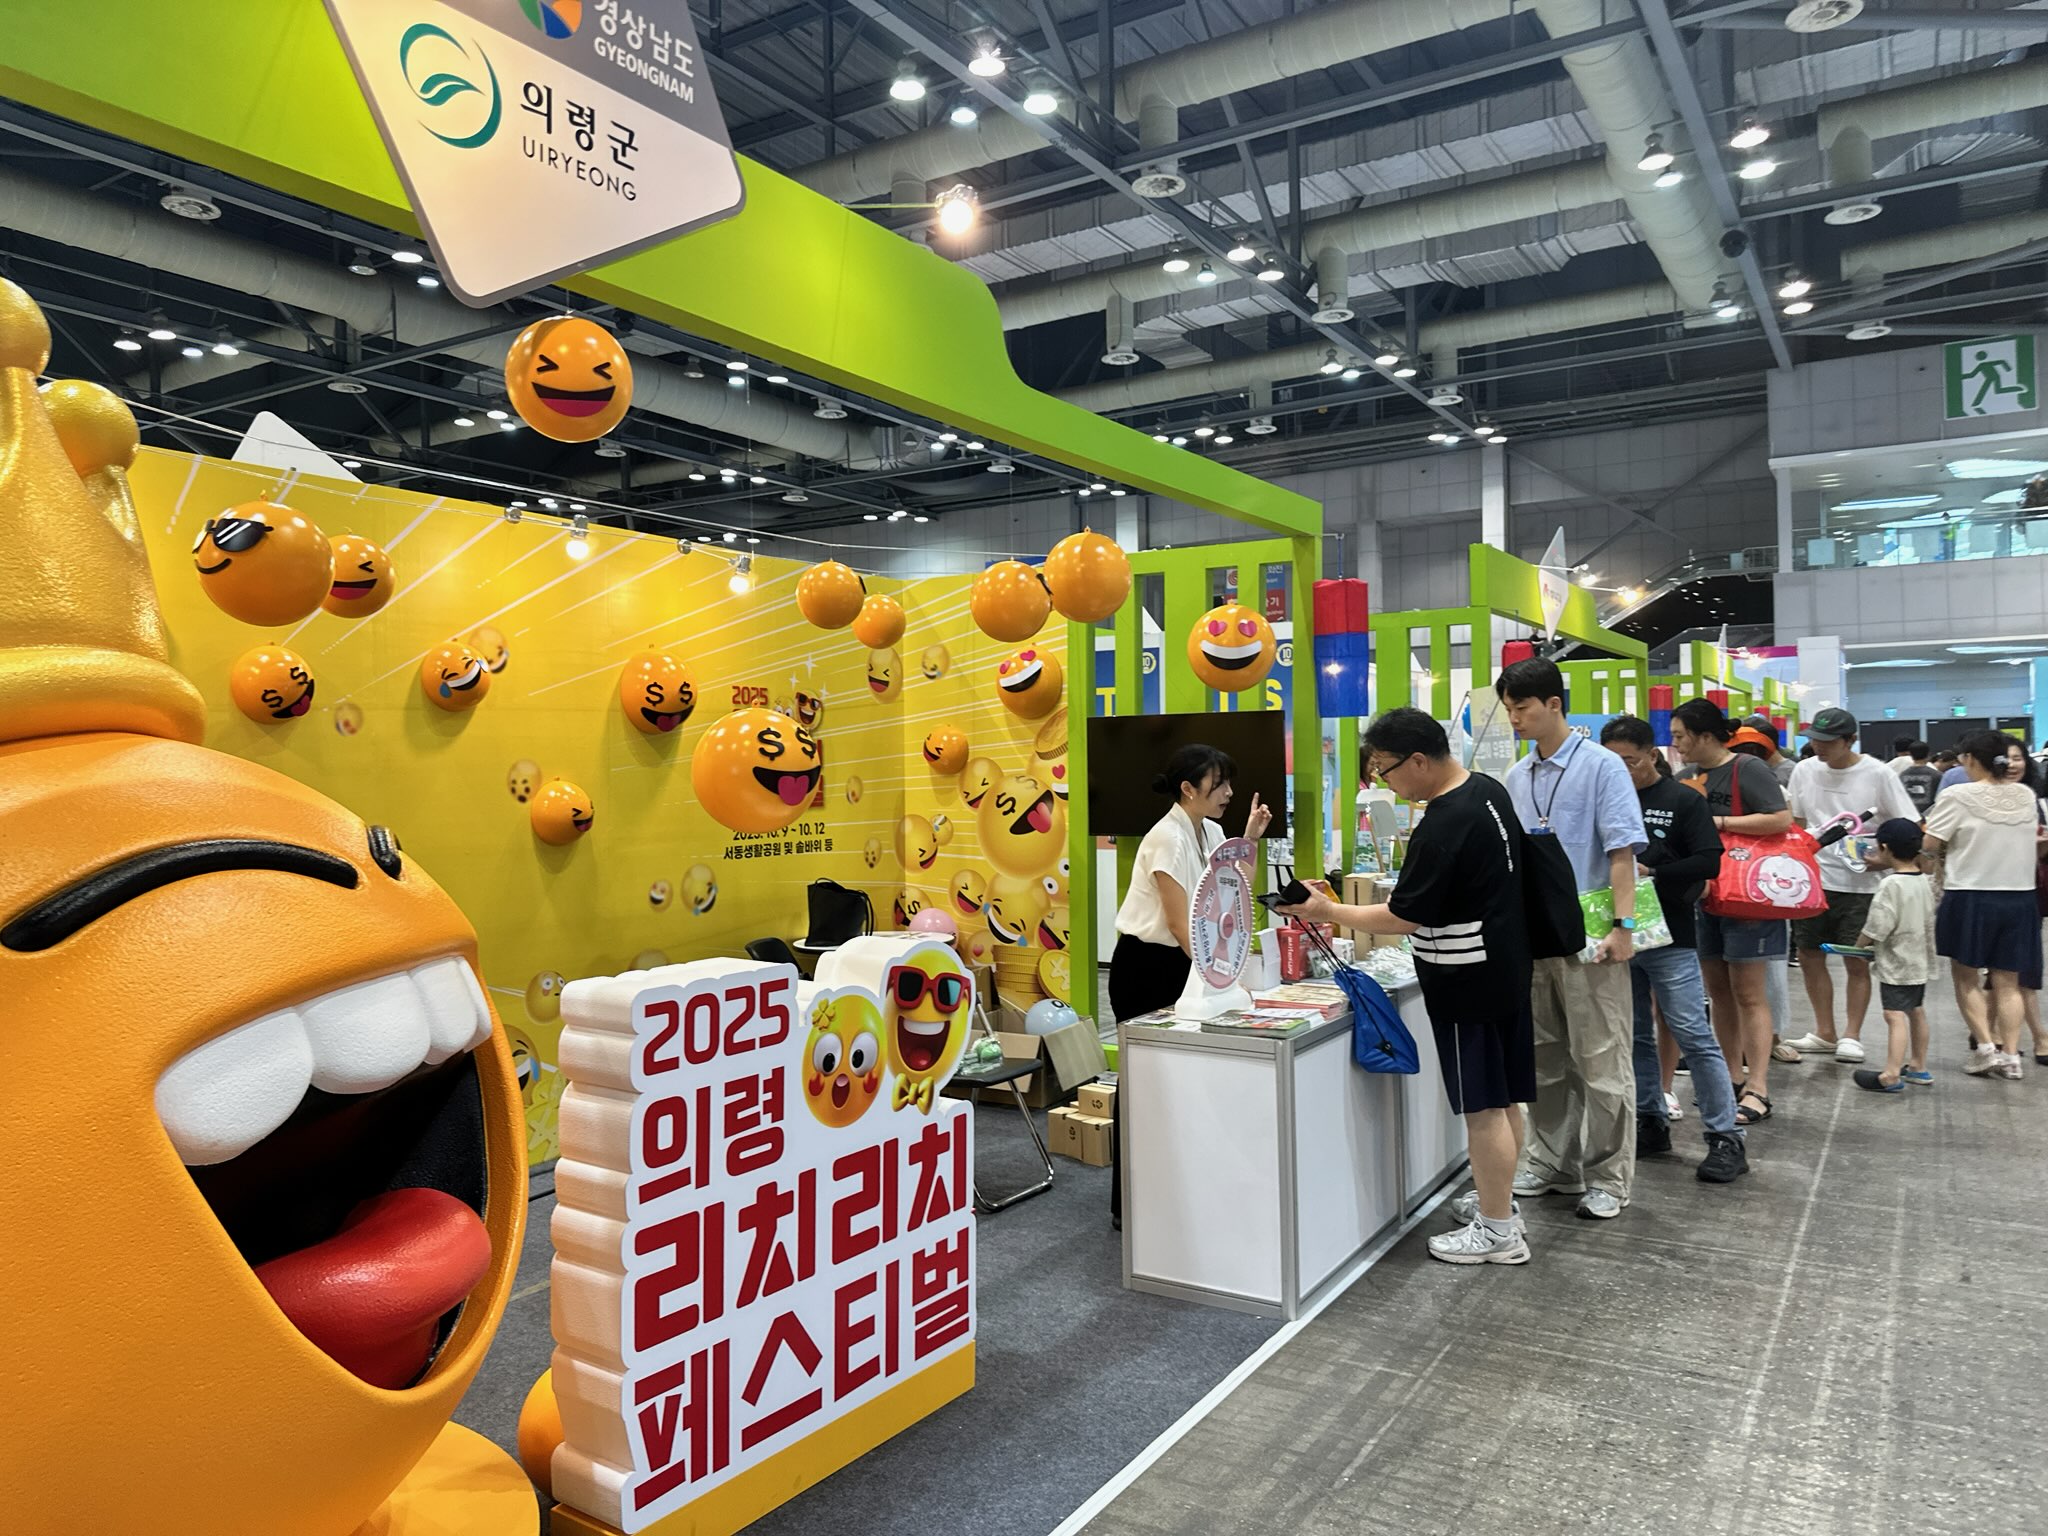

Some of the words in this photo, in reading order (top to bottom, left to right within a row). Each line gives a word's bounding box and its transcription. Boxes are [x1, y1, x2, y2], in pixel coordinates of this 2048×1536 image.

[594, 0, 695, 78] 경상남도
[594, 36, 694, 104] GYEONGNAM
[520, 81, 640, 171] 의령군
[522, 135, 637, 201] UIRYEONG
[732, 685, 768, 705] 2025
[723, 842, 781, 860] 서동생활공원
[824, 838, 833, 852] 등
[799, 823, 812, 836] 10.
[815, 822, 825, 835] 12
[643, 977, 790, 1076] 2025
[638, 1066, 785, 1204] 의령
[634, 1113, 968, 1353] 리치리치
[634, 1227, 970, 1512] 페스티벌
